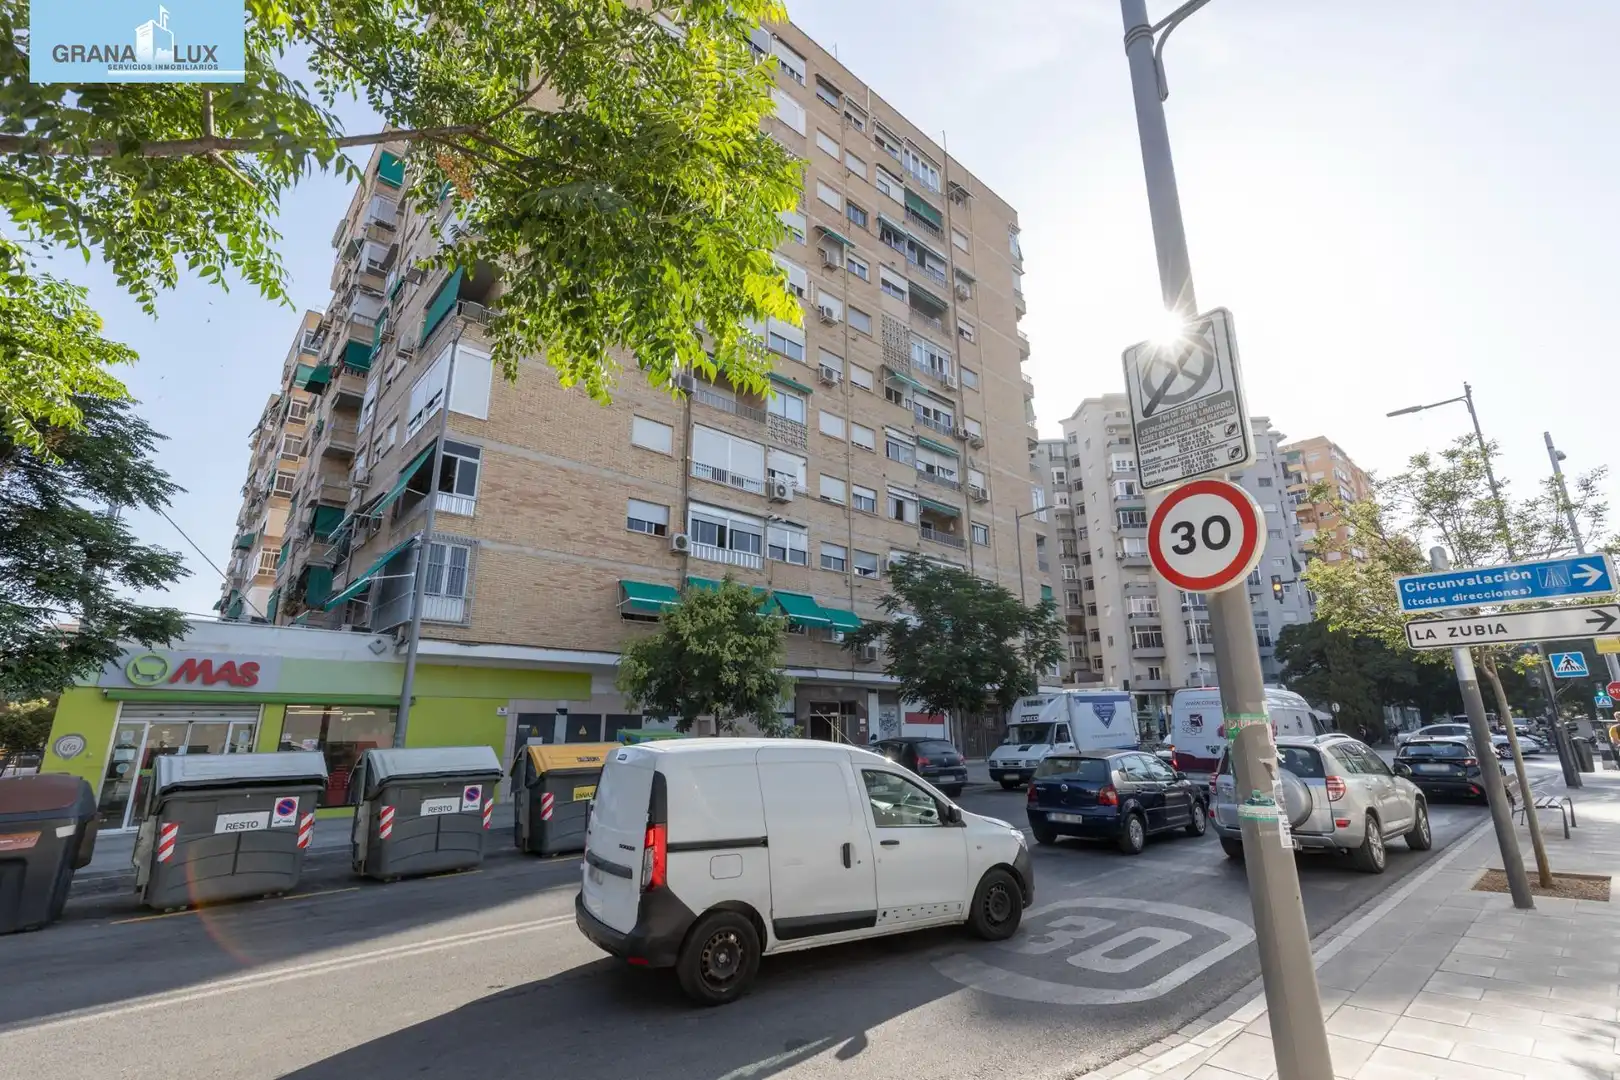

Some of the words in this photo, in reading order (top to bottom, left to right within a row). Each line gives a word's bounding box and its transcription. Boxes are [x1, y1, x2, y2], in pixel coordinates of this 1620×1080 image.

[1141, 410, 1198, 436] ESTACIONAMIENTO
[1198, 399, 1231, 417] LIMITADO
[1179, 403, 1198, 415] ZONA
[1198, 399, 1208, 409] DE
[1166, 420, 1192, 435] CONTROL
[1195, 405, 1235, 425] OBLIGATORIO
[1171, 515, 1231, 555] 30
[1404, 570, 1532, 593] Circunvalación
[1407, 596, 1446, 606] (todas
[1452, 586, 1532, 602] direcciones)
[1415, 628, 1437, 640] LA
[1447, 623, 1508, 638] ZUBIA
[169, 658, 260, 686] MAS
[225, 821, 259, 830] RESTO
[1004, 916, 1193, 973] 30
